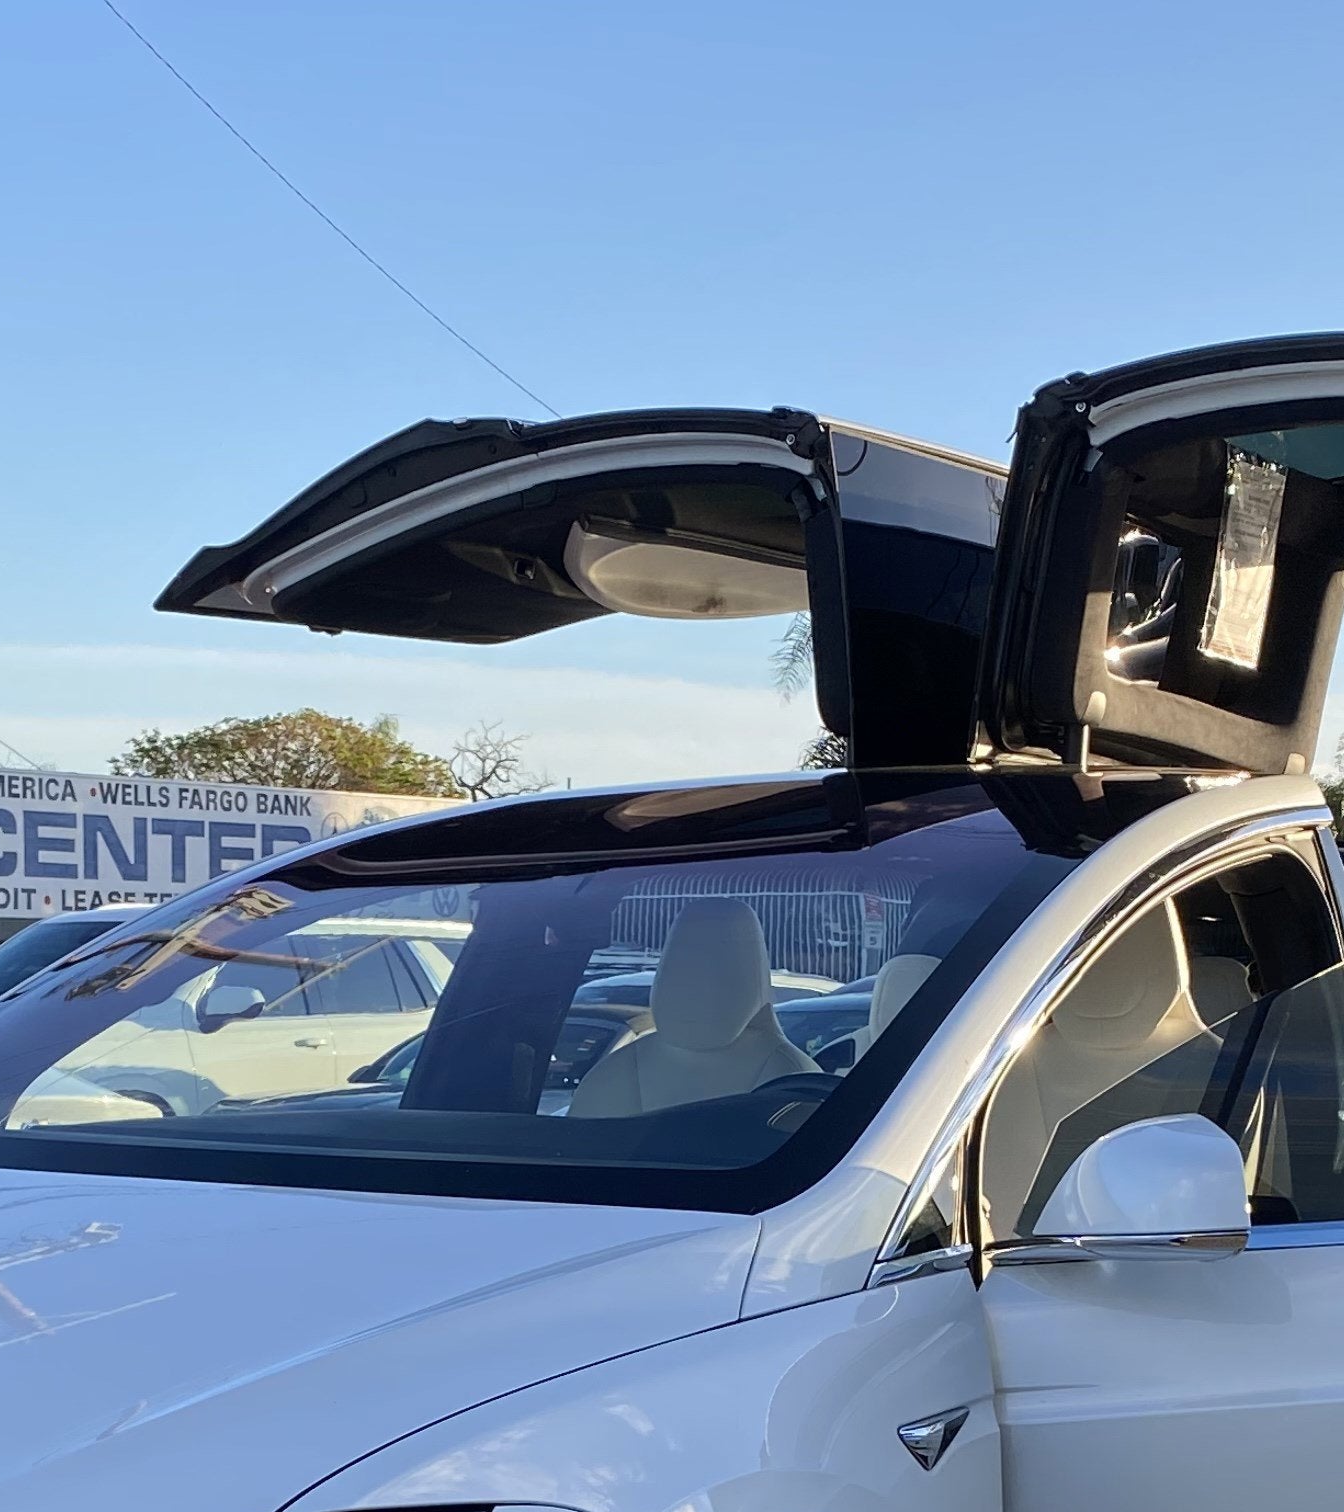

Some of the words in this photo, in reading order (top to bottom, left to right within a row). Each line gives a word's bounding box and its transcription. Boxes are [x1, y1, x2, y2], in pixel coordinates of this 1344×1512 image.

[98, 781, 170, 809] WELLS
[178, 787, 248, 813] FARGO
[256, 793, 312, 817] BANK
